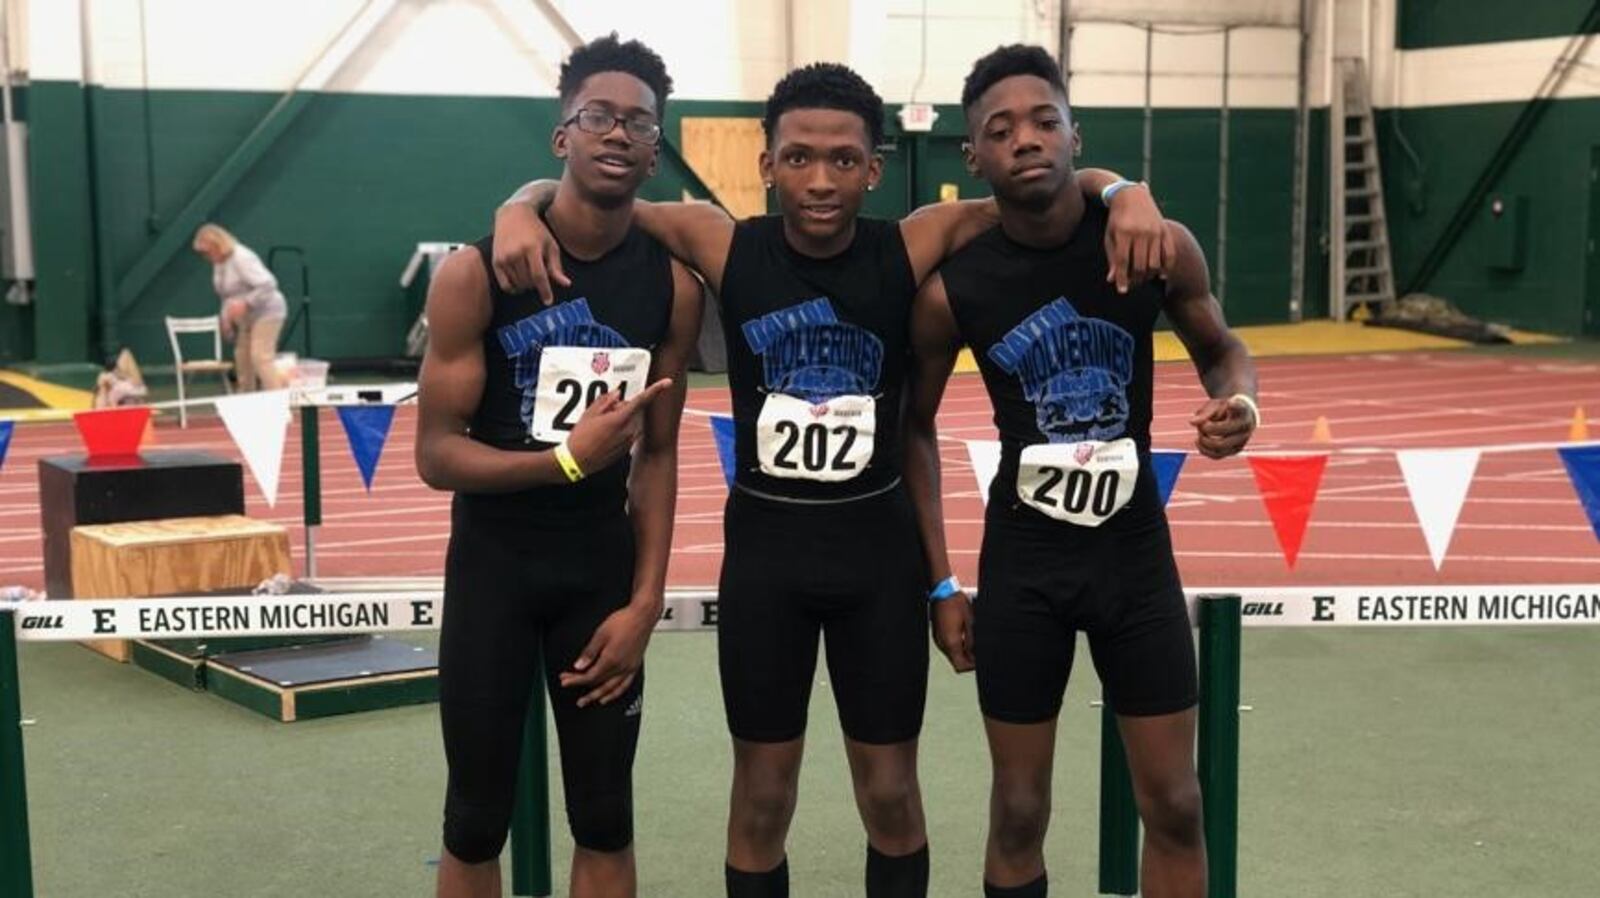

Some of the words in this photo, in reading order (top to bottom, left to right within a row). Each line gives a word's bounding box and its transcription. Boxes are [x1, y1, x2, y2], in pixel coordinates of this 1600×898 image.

[762, 322, 884, 390] WOLVERINES
[1017, 316, 1135, 402] WOLVERINES
[773, 420, 857, 472] 202
[1033, 466, 1120, 517] 200
[21, 615, 64, 629] GILL
[92, 609, 116, 633] E
[139, 606, 249, 632] EASTERN
[260, 602, 389, 628] MICHIGAN
[411, 601, 433, 625] E
[1242, 602, 1284, 616] GILL
[1312, 596, 1335, 621] E
[1357, 595, 1467, 620] EASTERN
